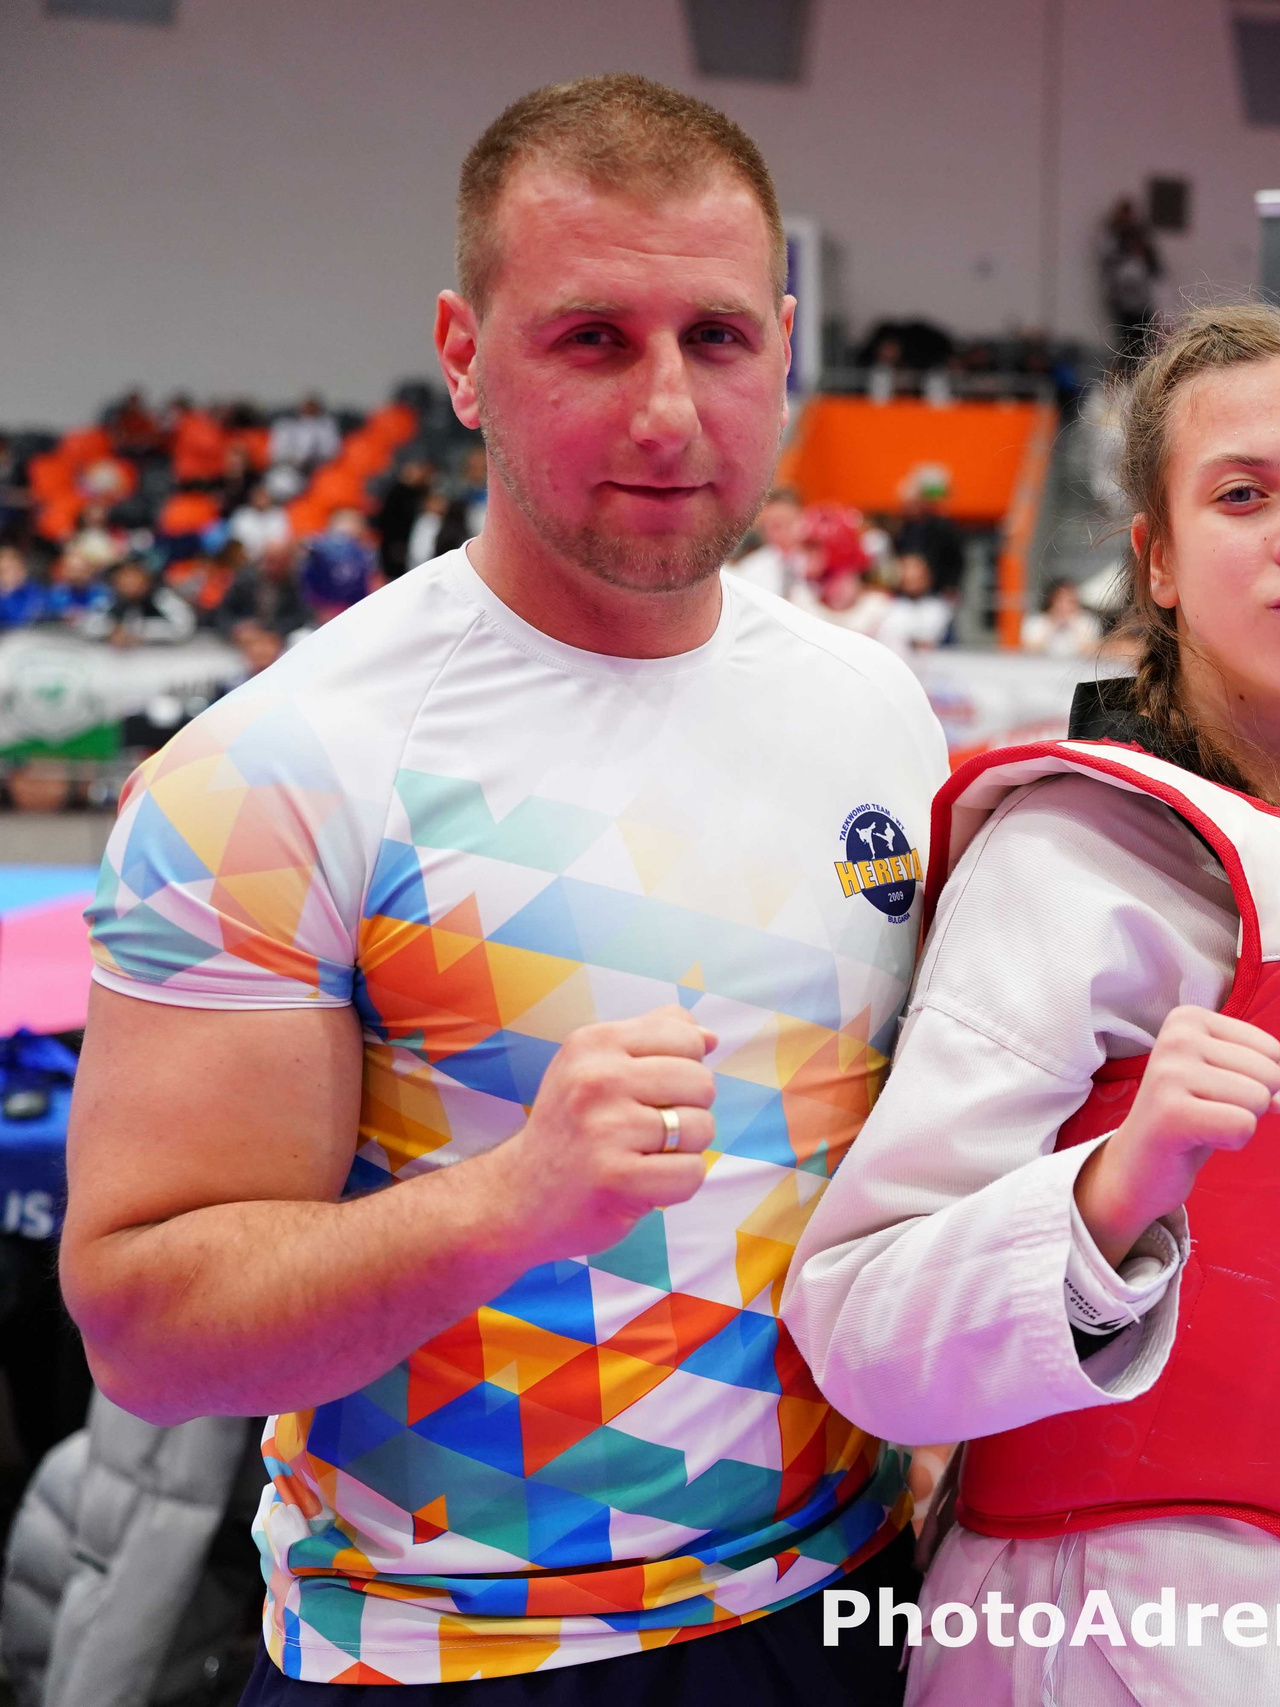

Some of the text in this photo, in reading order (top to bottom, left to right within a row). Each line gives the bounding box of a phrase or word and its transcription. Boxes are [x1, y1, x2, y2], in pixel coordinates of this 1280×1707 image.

[839, 803, 871, 841] TAEKWONDO
[872, 803, 891, 816] TEAM
[834, 848, 923, 898] HEREYA
[888, 890, 904, 902] 2009
[887, 912, 910, 924] BULGARIA
[1064, 1277, 1102, 1316] TAEKWOND
[1070, 1297, 1096, 1320] WORLD
